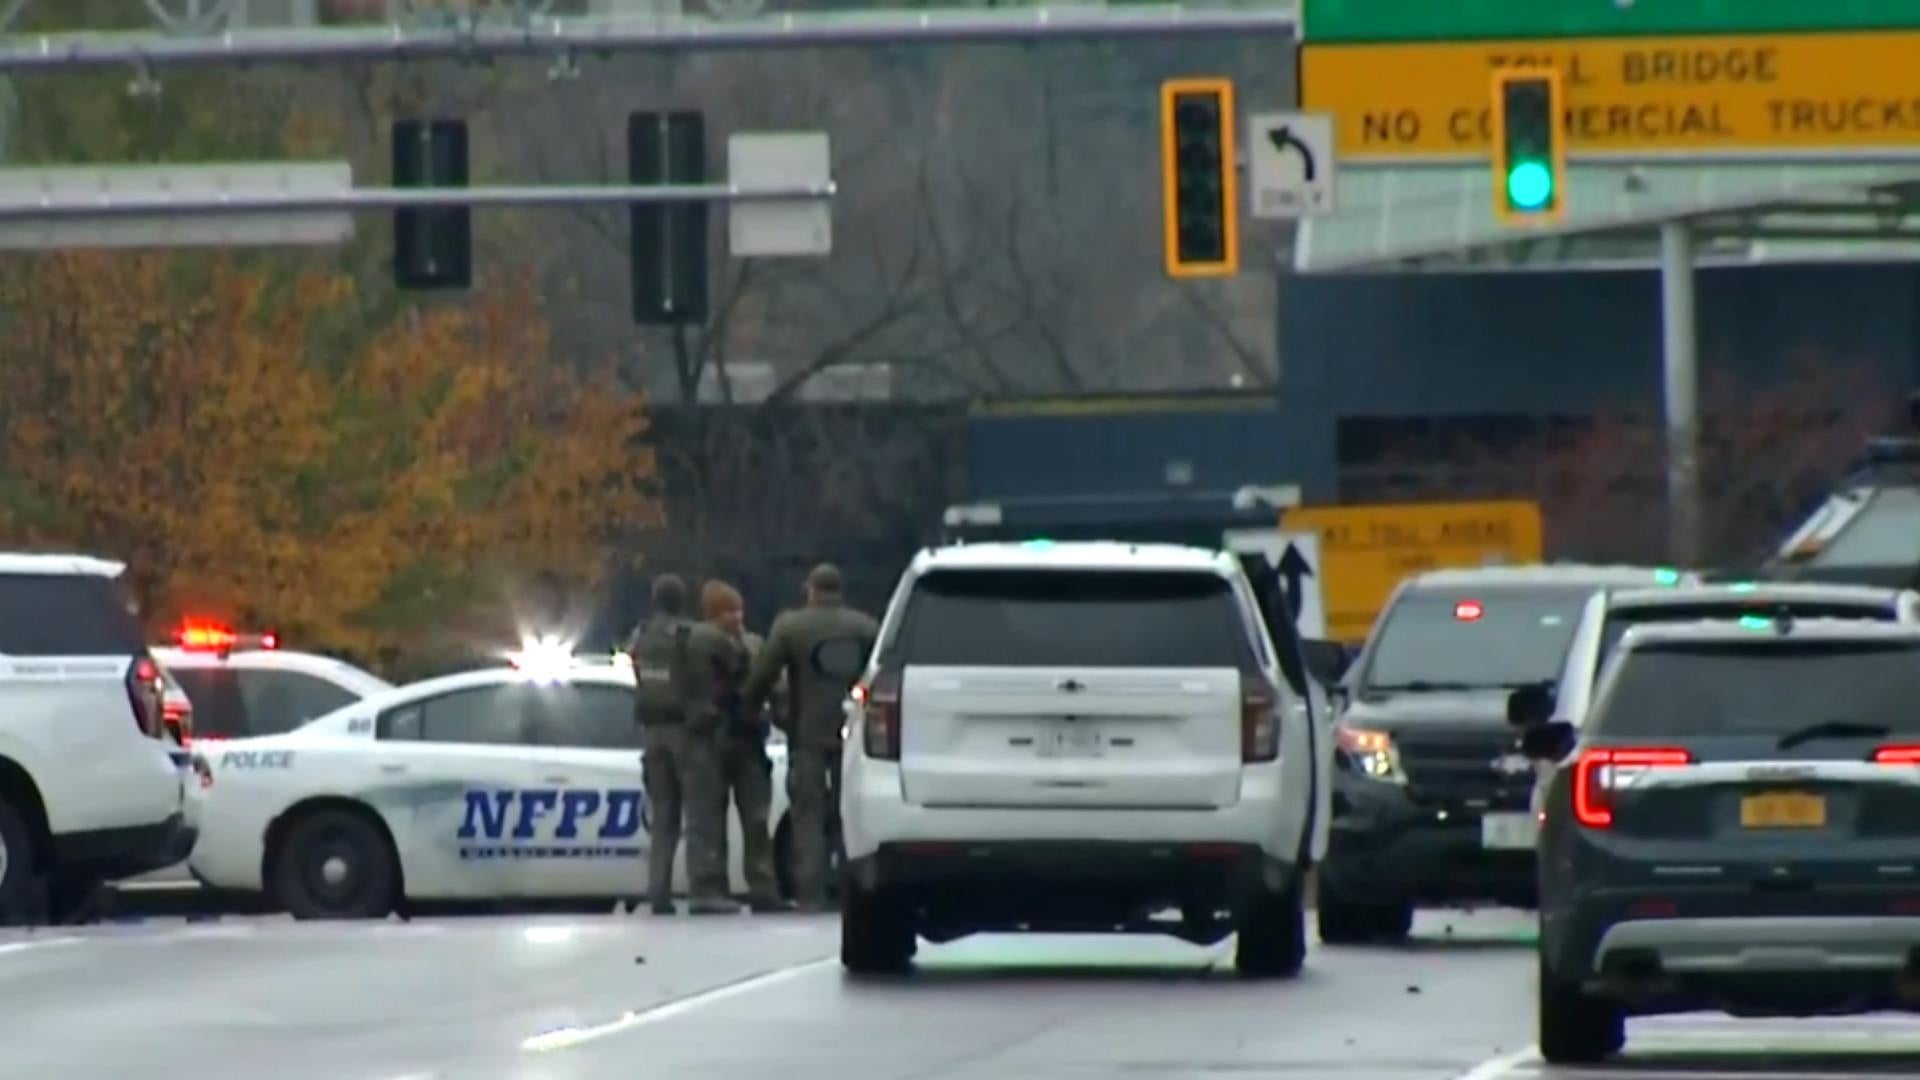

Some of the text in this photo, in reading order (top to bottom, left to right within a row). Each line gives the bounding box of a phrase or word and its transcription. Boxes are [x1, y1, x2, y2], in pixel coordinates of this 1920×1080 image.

[1622, 47, 1777, 84] BRIDGE
[1362, 108, 1421, 143] NO
[1447, 101, 1735, 142] COERCIAL
[220, 751, 295, 769] POLICE
[457, 789, 642, 839] NFPD
